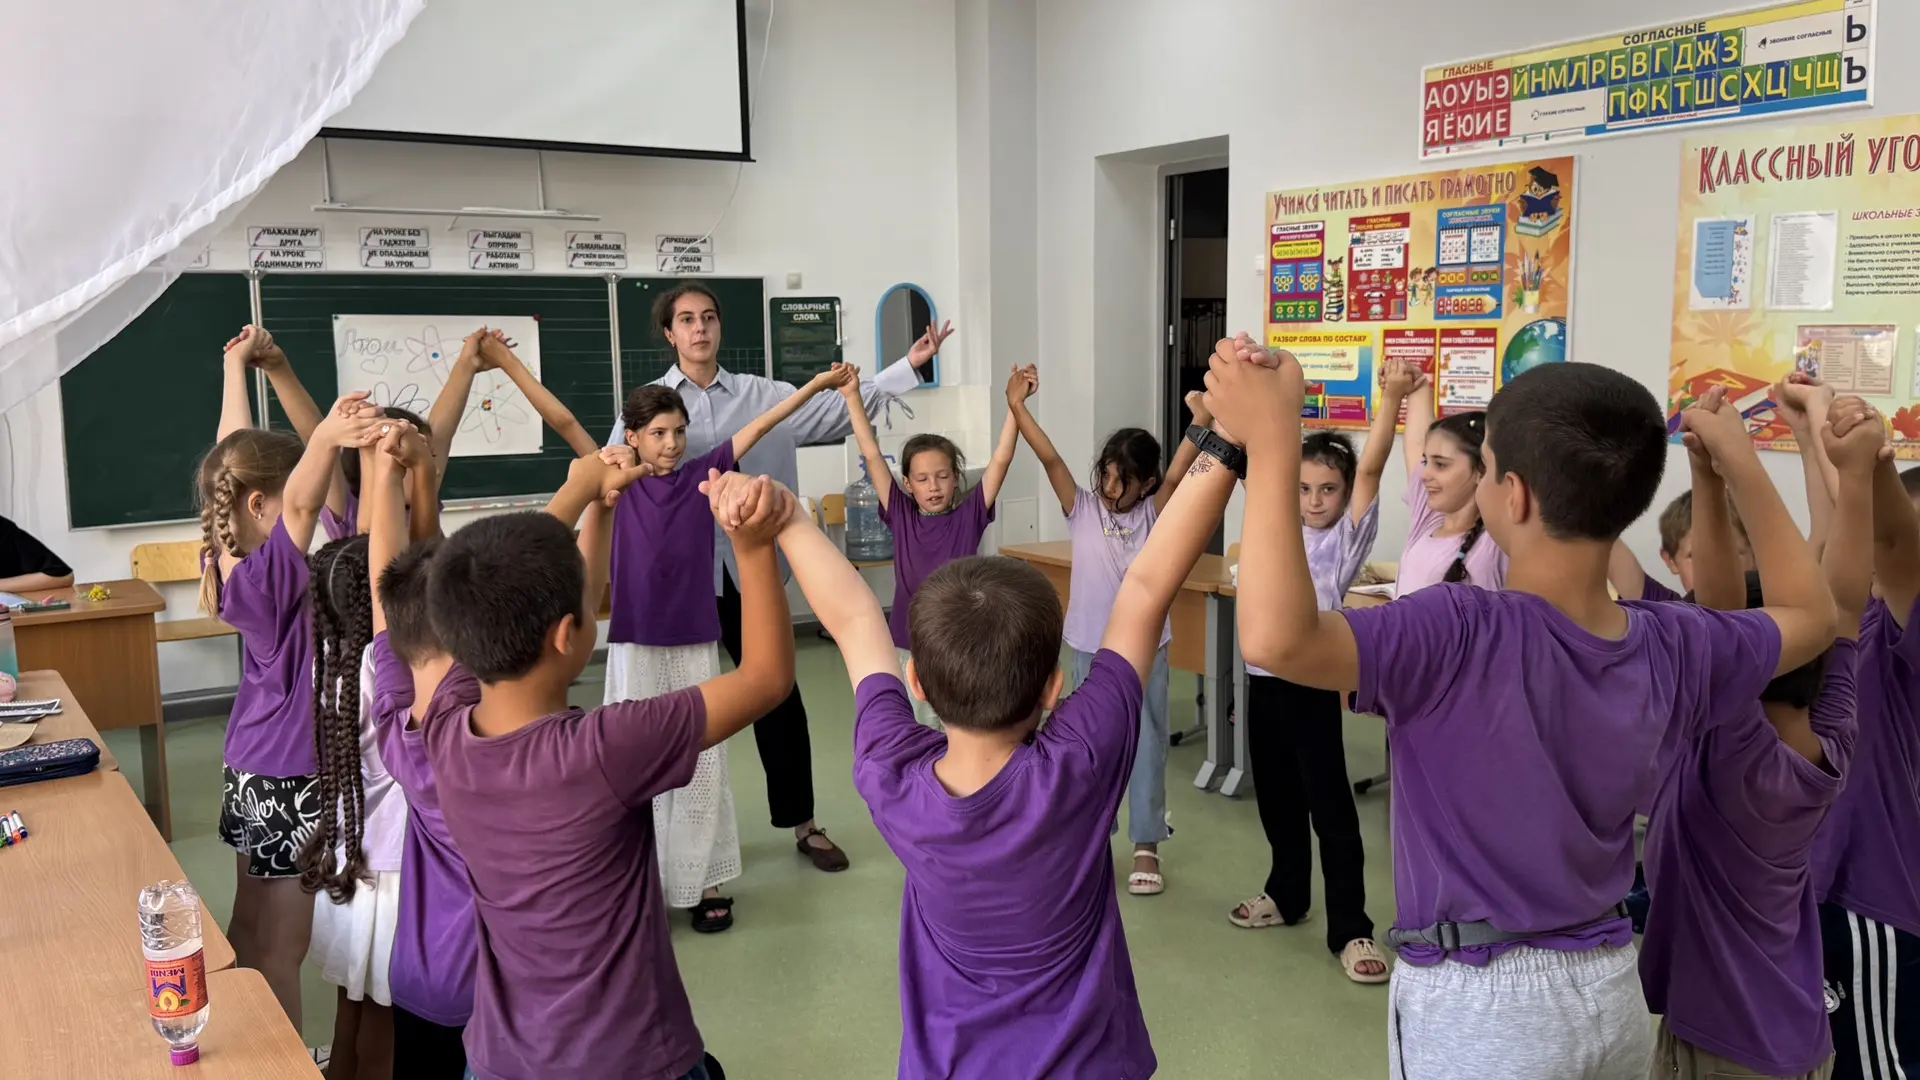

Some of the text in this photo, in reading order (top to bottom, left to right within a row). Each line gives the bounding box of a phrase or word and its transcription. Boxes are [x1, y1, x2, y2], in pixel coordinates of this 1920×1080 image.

[1846, 14, 1867, 43] Ь
[1622, 21, 1707, 47] СОГЛАСНЫЕ
[1796, 29, 1833, 40] СОГЛАСНЫЕ
[1442, 60, 1494, 79] ГЛАСНЫЕ
[1843, 56, 1867, 85] Ъ
[1323, 189, 1368, 212] ЧИТАТЬ
[1372, 185, 1381, 207] И
[1384, 180, 1435, 206] ПИСАТЬ
[1440, 170, 1517, 199] ГРАМОТНО
[1852, 208, 1914, 221] ШКОЛЬНЫЕ
[262, 228, 319, 237] УВАЖАЕМ ДРУГ
[373, 228, 421, 237] НА УРОКЕ БЕЗ
[280, 239, 303, 247] ДРУГА
[379, 239, 417, 247] ГАДЖЕТОВ
[270, 250, 306, 258] НА УРОКЕ
[379, 250, 429, 258] ОПАЗДЫВАЕМ
[254, 260, 324, 269] ПОДНИМАЕМ РУКУ
[385, 260, 415, 268] НА УРОК
[781, 303, 831, 311] СЛОВАРНЫЕ
[793, 313, 820, 321] СЛОВА
[1273, 335, 1367, 343] РАЗБОР СЛОВА ПО СОСТАВУ
